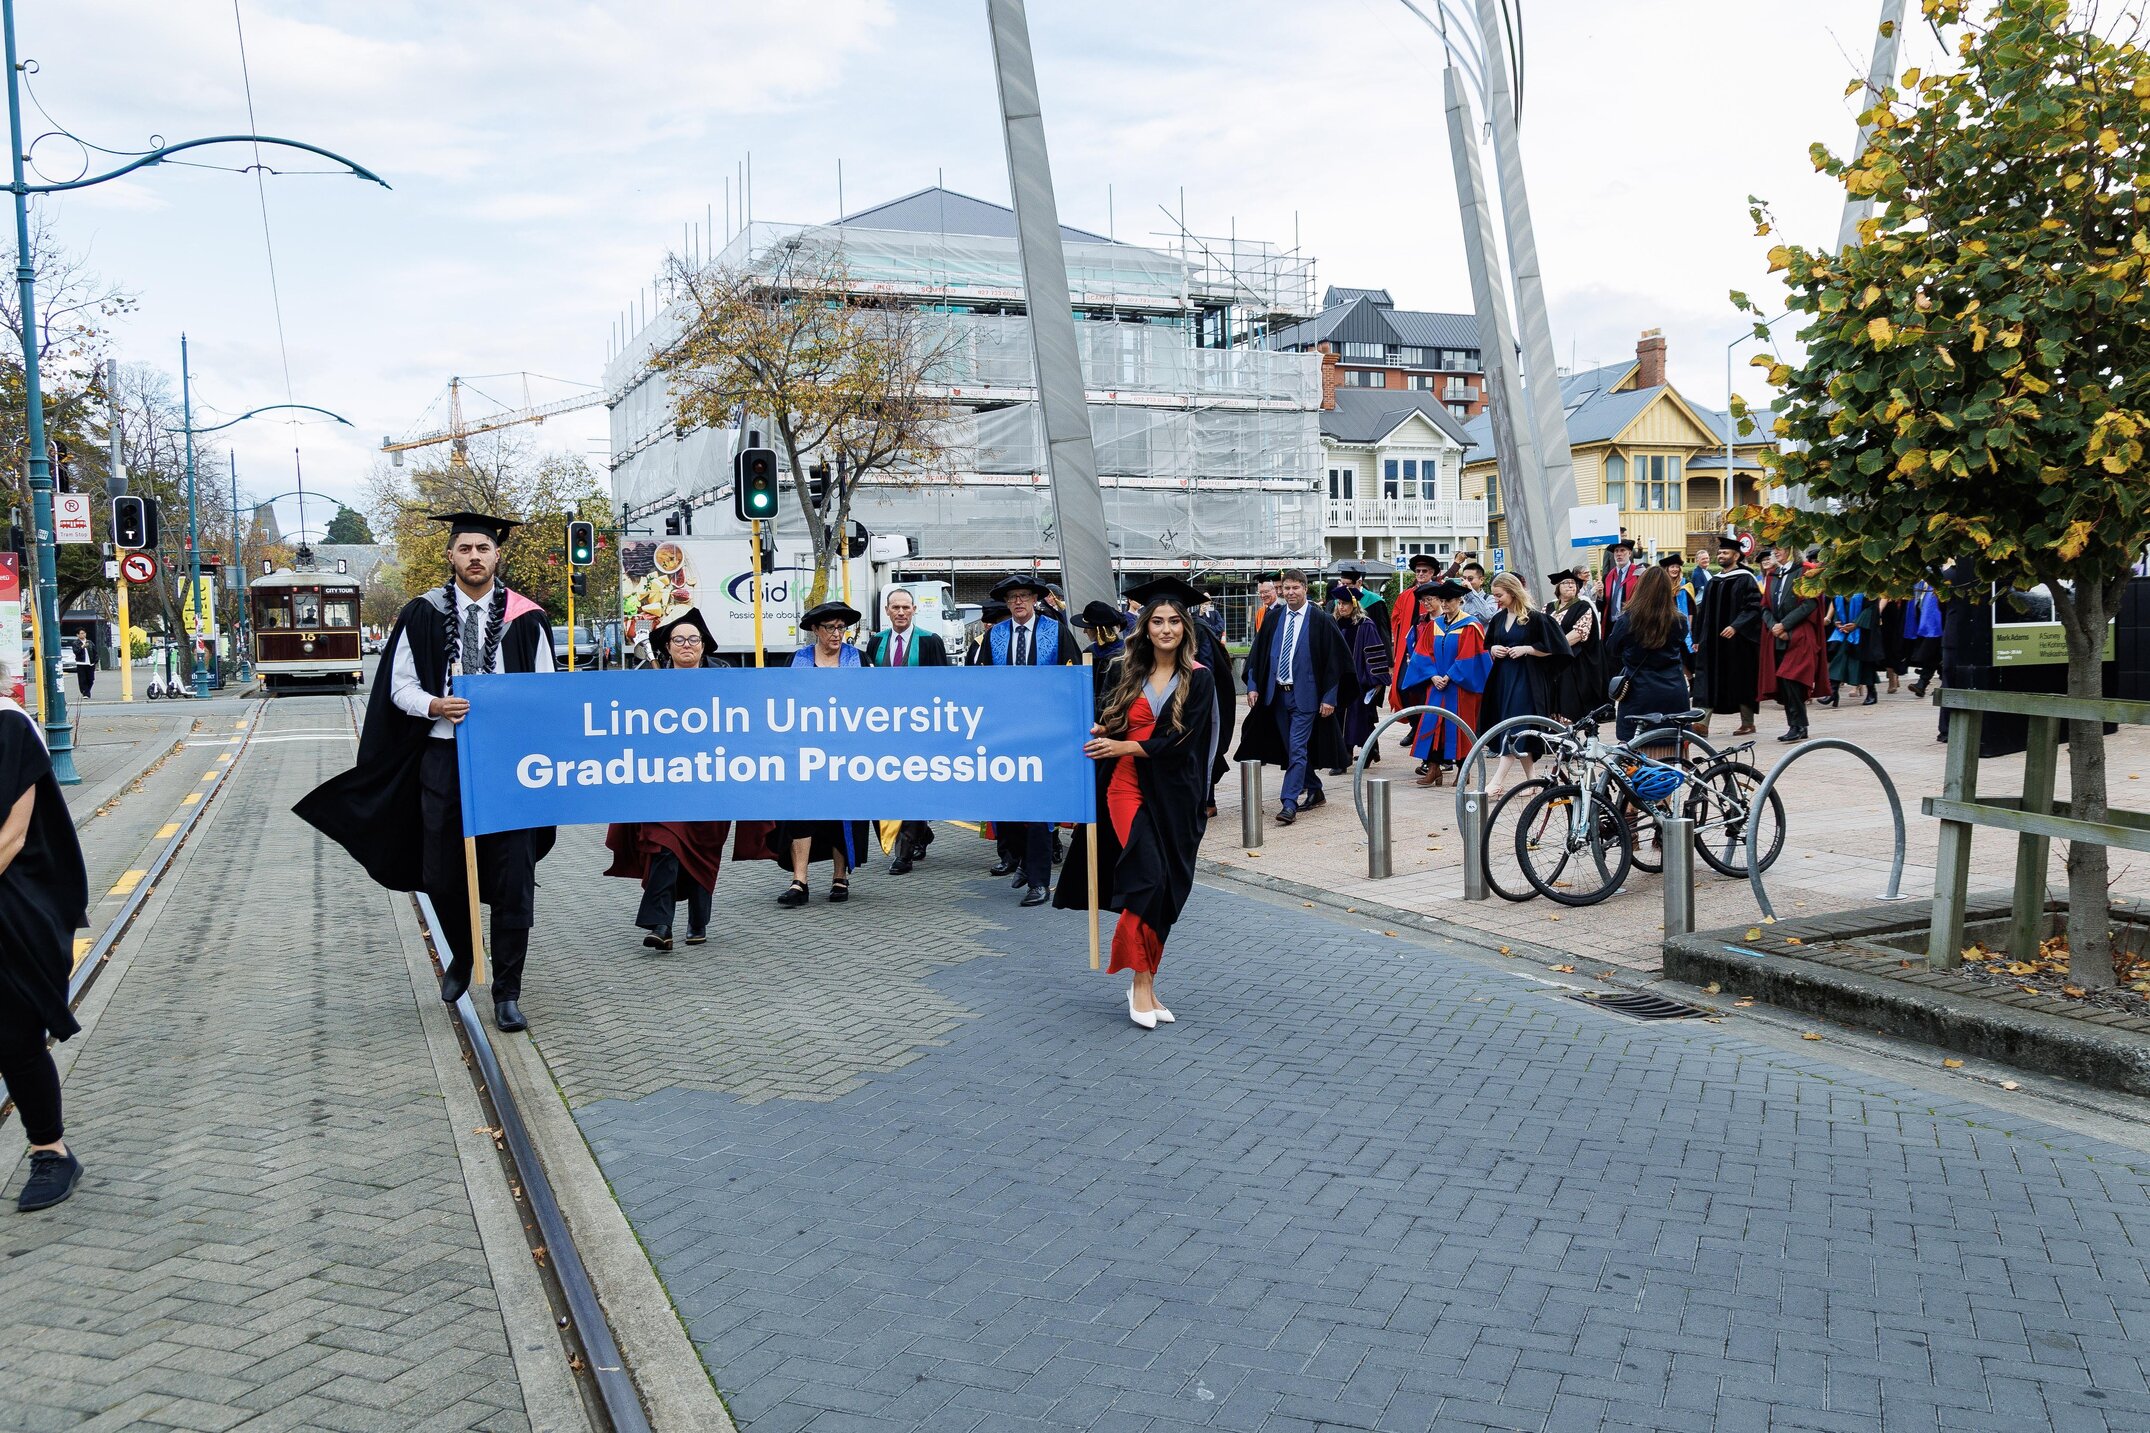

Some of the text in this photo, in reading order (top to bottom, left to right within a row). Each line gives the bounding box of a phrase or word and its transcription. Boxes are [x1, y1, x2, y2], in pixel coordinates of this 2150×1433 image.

[264, 560, 271, 574] B
[338, 560, 346, 573] B
[730, 610, 801, 619] Passiote about
[301, 633, 316, 641] 15
[584, 697, 983, 739] Lincoln University
[517, 746, 1042, 788] Graduation Procession
